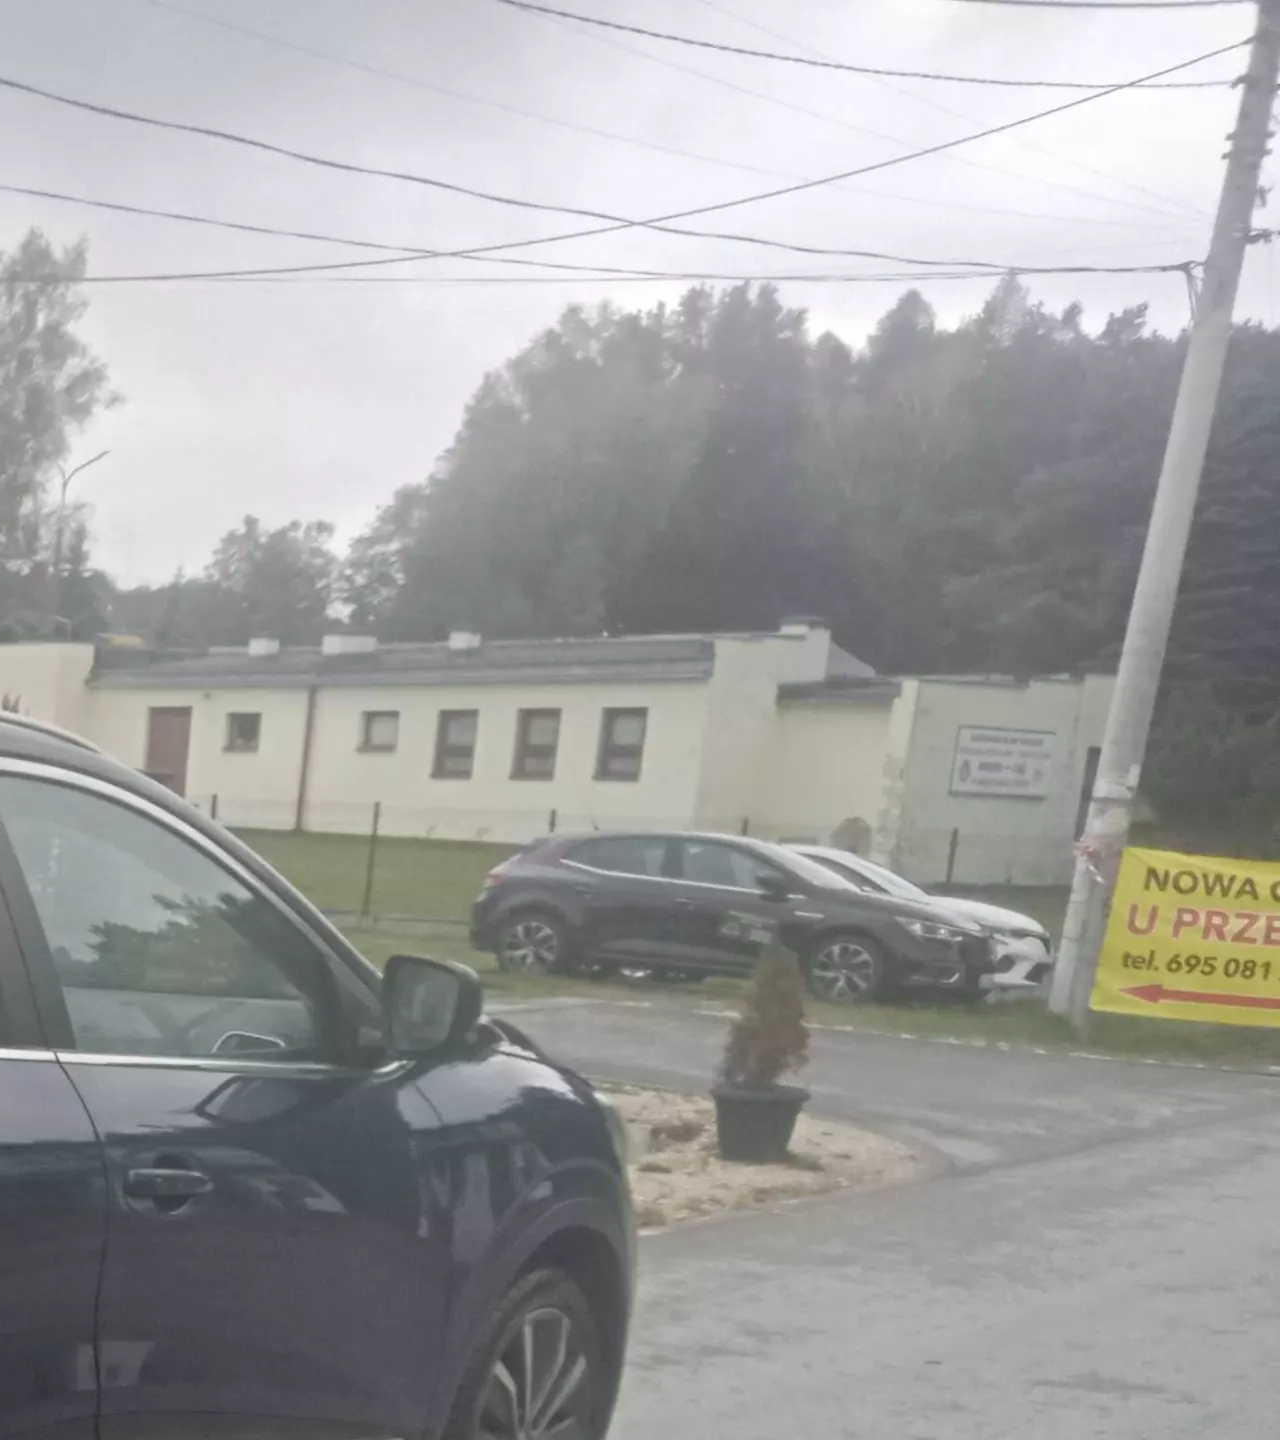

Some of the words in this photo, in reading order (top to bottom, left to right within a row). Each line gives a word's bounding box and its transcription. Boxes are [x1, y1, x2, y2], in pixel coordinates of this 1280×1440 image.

[1143, 866, 1260, 901] NOWA
[1127, 903, 1160, 936] U
[1122, 950, 1159, 971] tel.
[1166, 953, 1217, 976] 695
[1223, 957, 1272, 981] 081
